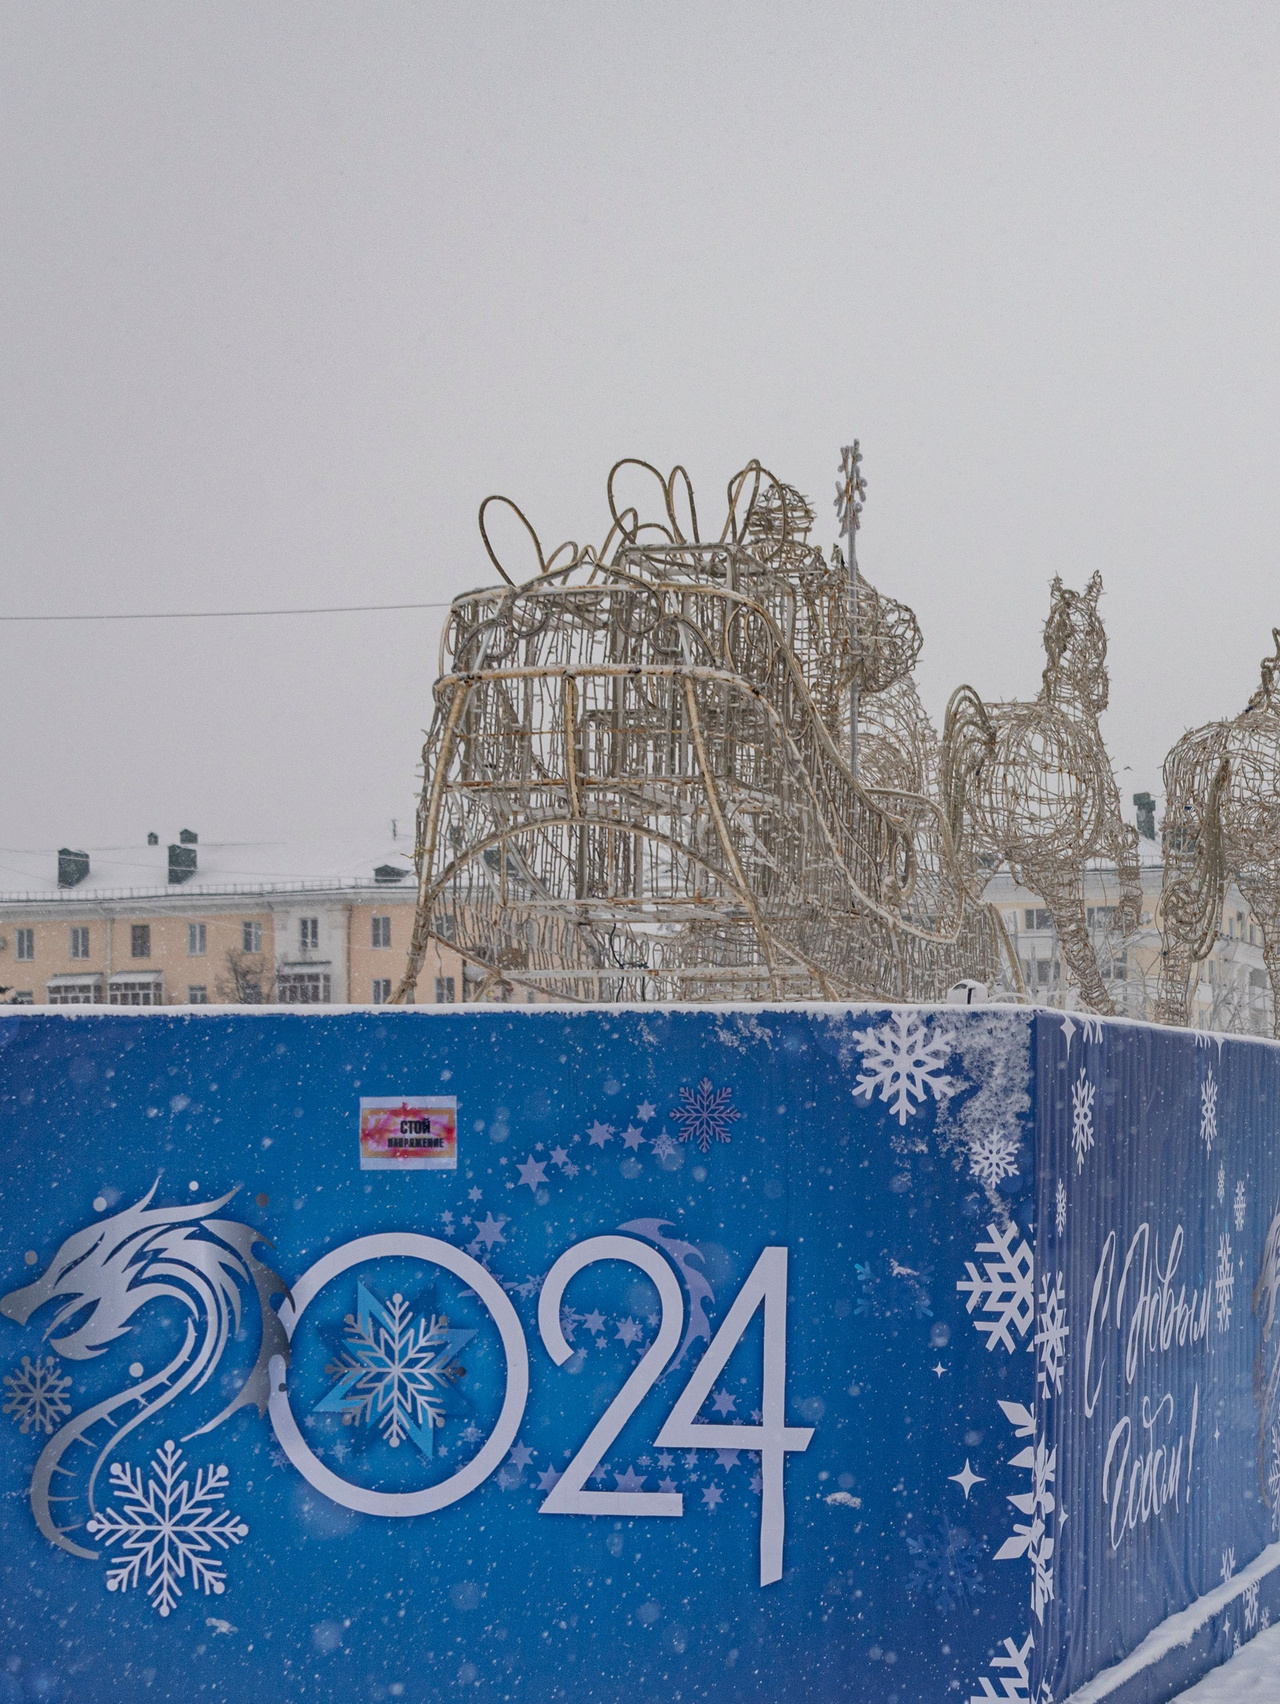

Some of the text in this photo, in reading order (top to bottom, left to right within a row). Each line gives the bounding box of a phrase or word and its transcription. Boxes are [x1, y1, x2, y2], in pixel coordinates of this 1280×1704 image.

[387, 1137, 444, 1148] НАПРЯЖЕНИЕ
[400, 1118, 431, 1135] СТОЙ
[1084, 1222, 1213, 1419] С Новым
[1102, 1381, 1199, 1551] Годом!
